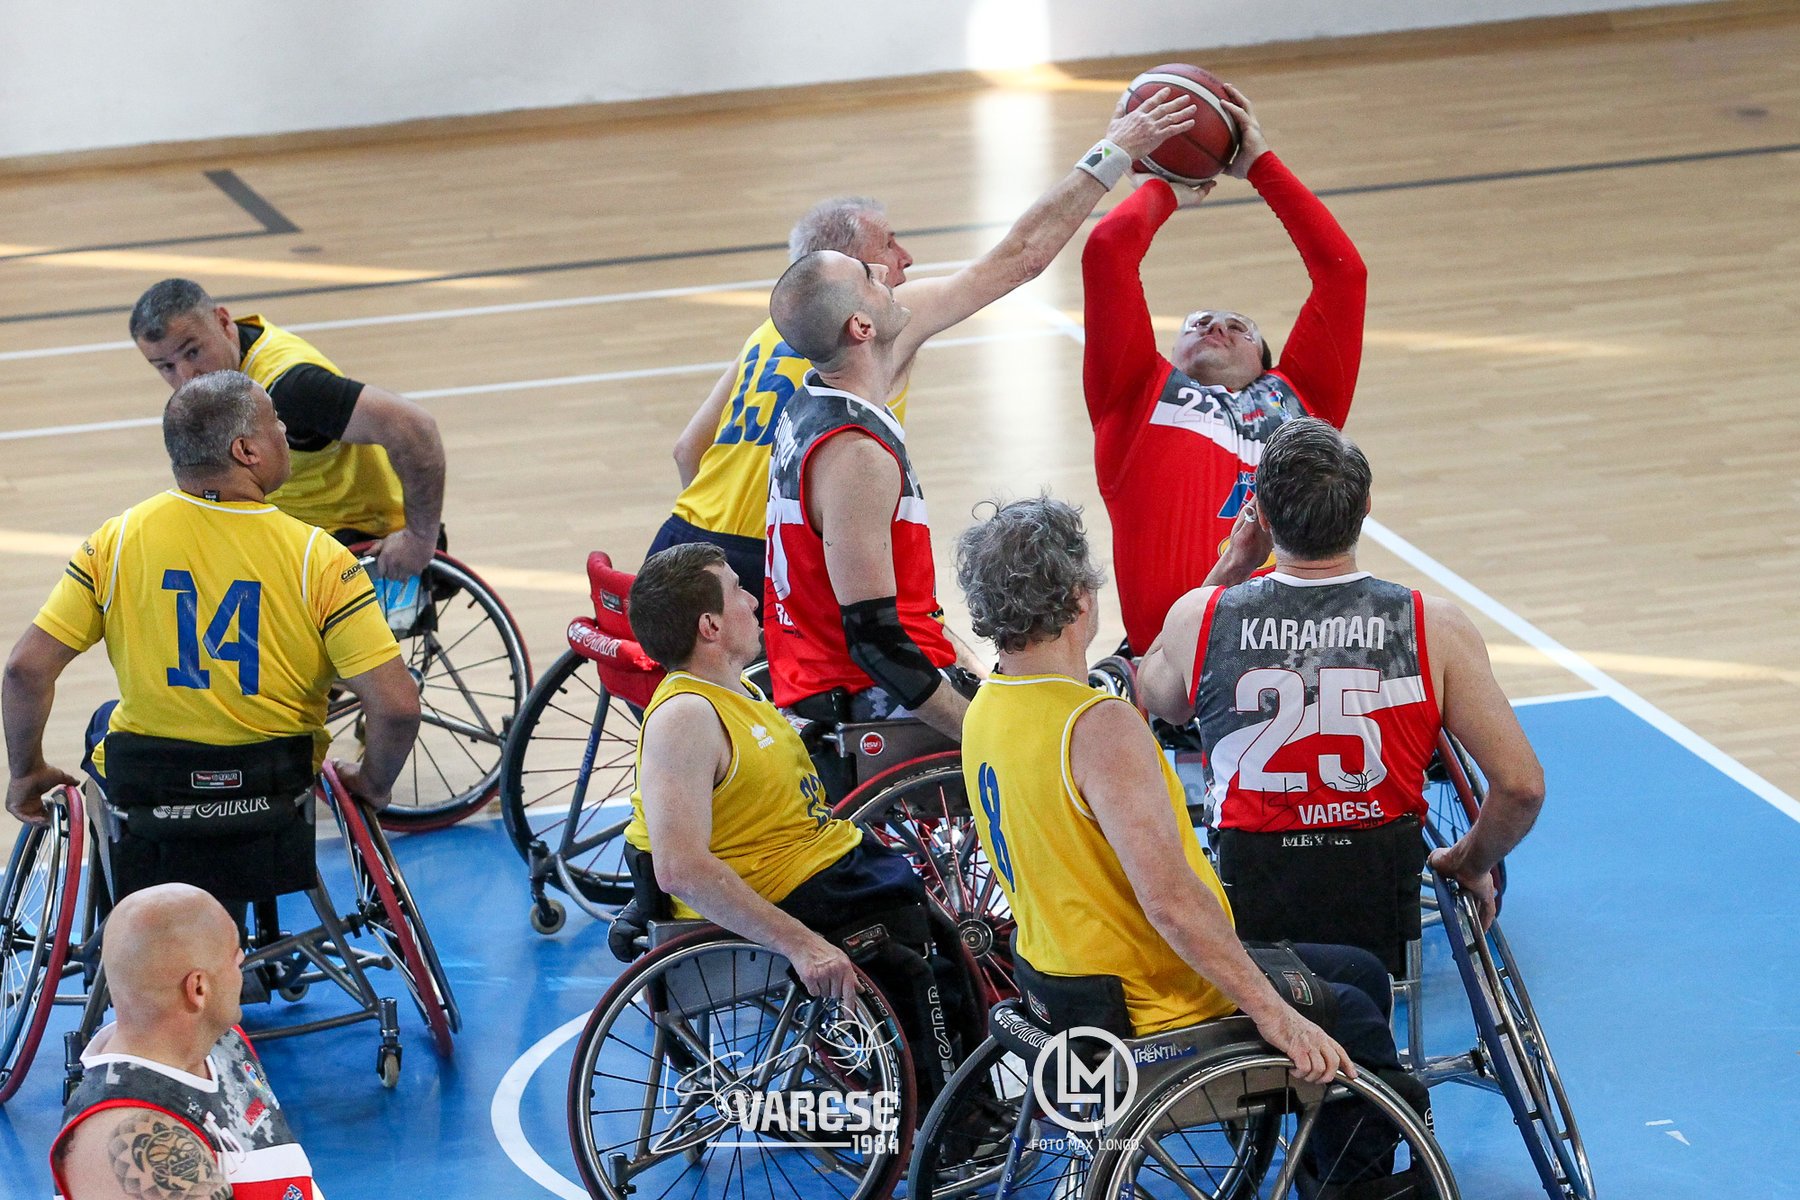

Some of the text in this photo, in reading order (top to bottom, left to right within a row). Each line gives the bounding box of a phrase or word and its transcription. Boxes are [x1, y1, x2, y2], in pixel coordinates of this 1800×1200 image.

[715, 341, 804, 446] 15
[161, 569, 262, 696] 14
[1240, 615, 1385, 650] KARAMAN
[1235, 667, 1388, 792] 25
[978, 762, 1016, 893] 8
[1298, 800, 1384, 825] VARESE
